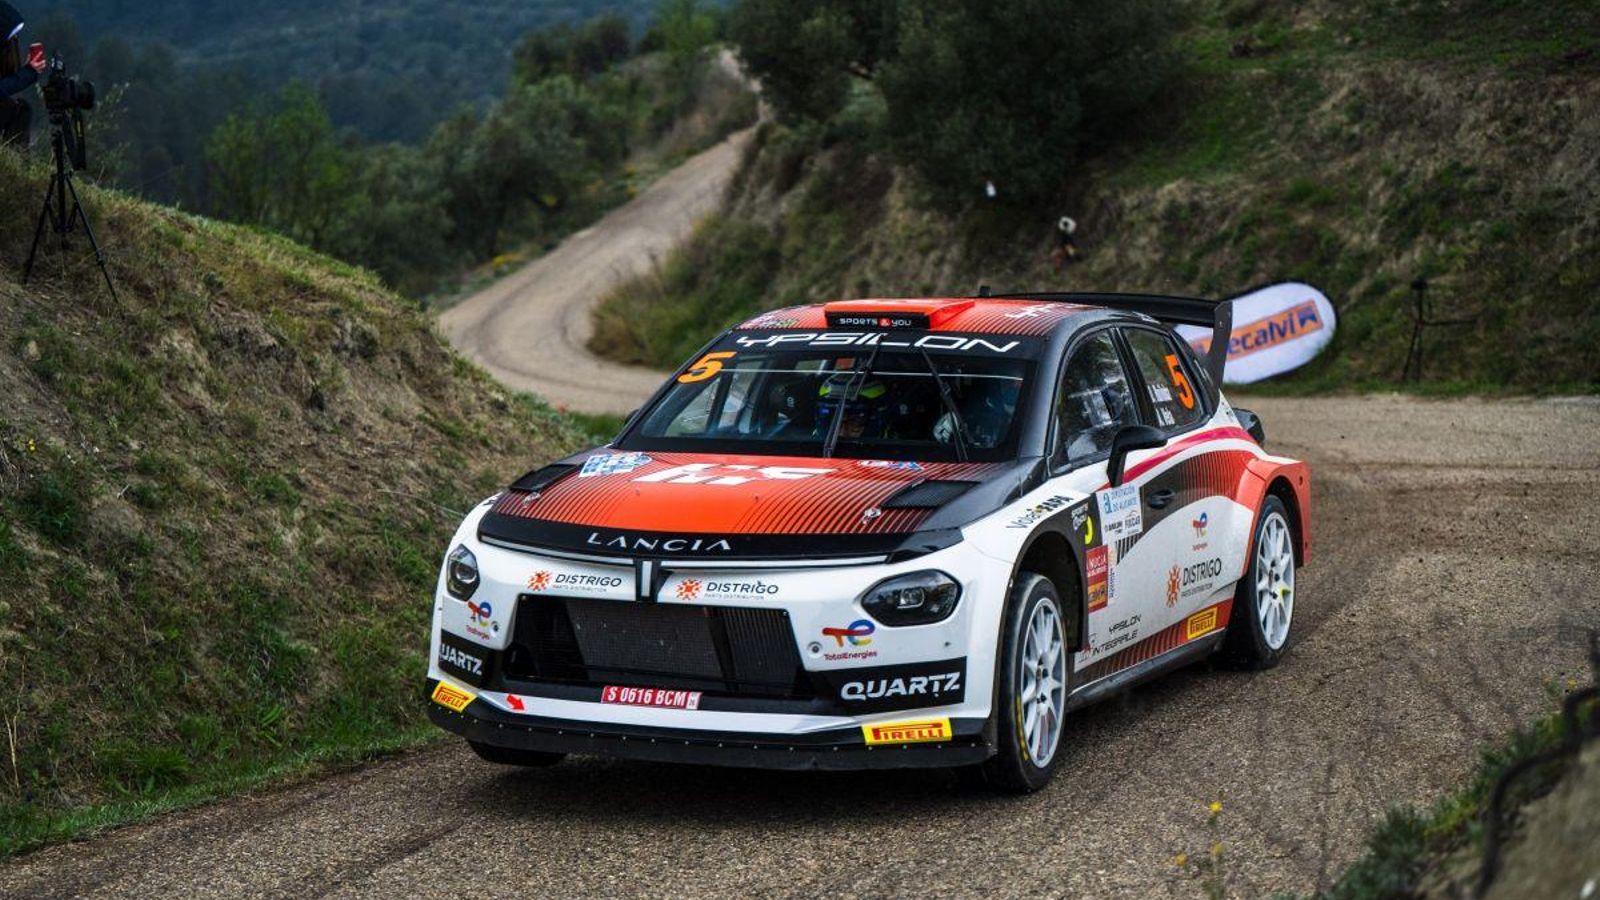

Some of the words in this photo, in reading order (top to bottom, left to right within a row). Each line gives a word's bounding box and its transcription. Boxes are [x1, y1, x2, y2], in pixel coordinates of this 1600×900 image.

[839, 317, 878, 326] SPORTS
[891, 318, 912, 327] YOU
[736, 332, 1020, 353] YPSILON
[1227, 312, 1296, 354] ecalvi
[677, 351, 737, 384] 5
[1164, 353, 1194, 410] 5
[587, 533, 732, 552] LANCIA
[555, 573, 622, 588] DISTRIGO
[1182, 557, 1222, 587] DISTRIGO
[706, 581, 780, 595] DISTRIGO
[1108, 614, 1142, 635] YPSILON
[439, 644, 483, 675] UARTZ
[823, 650, 878, 661] TotalEnergies
[436, 685, 470, 708] PIRELLI
[608, 686, 618, 701] S
[620, 687, 654, 704] 0616
[655, 689, 687, 706] BCM
[840, 671, 961, 701] QUARTZ
[871, 722, 944, 741] PIRELLI
